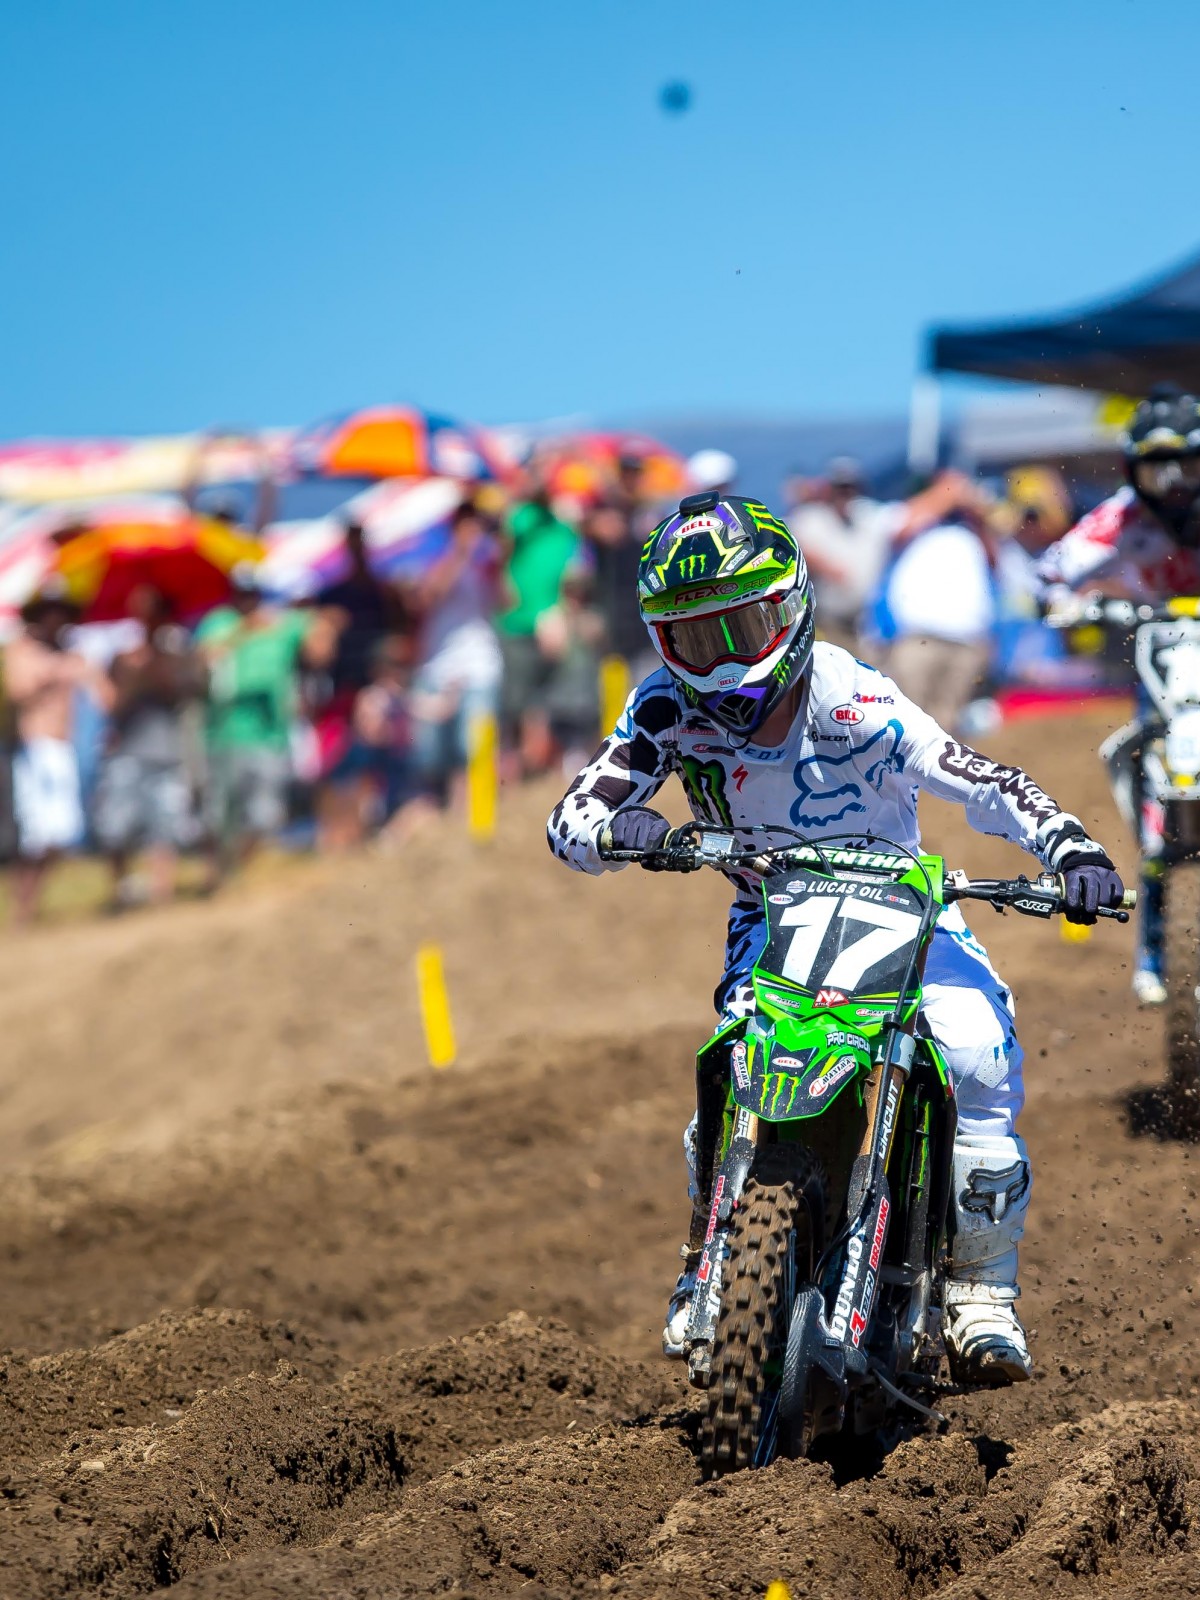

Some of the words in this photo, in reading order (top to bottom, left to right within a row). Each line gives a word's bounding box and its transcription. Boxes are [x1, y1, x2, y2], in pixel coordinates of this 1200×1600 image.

[681, 520, 714, 533] BELL
[719, 677, 737, 686] BELL
[744, 748, 786, 760] FOX
[795, 846, 916, 871] RENTHA
[807, 881, 858, 895] LUCAS
[859, 886, 884, 901] OIL
[1014, 899, 1053, 913] ARC
[779, 895, 922, 991] 17
[826, 1031, 845, 1047] PRO
[846, 1032, 870, 1054] CIRCUI
[822, 1058, 852, 1086] MAXIMA
[877, 1079, 900, 1161] CIRCUIT
[869, 1196, 891, 1272] BRAKING
